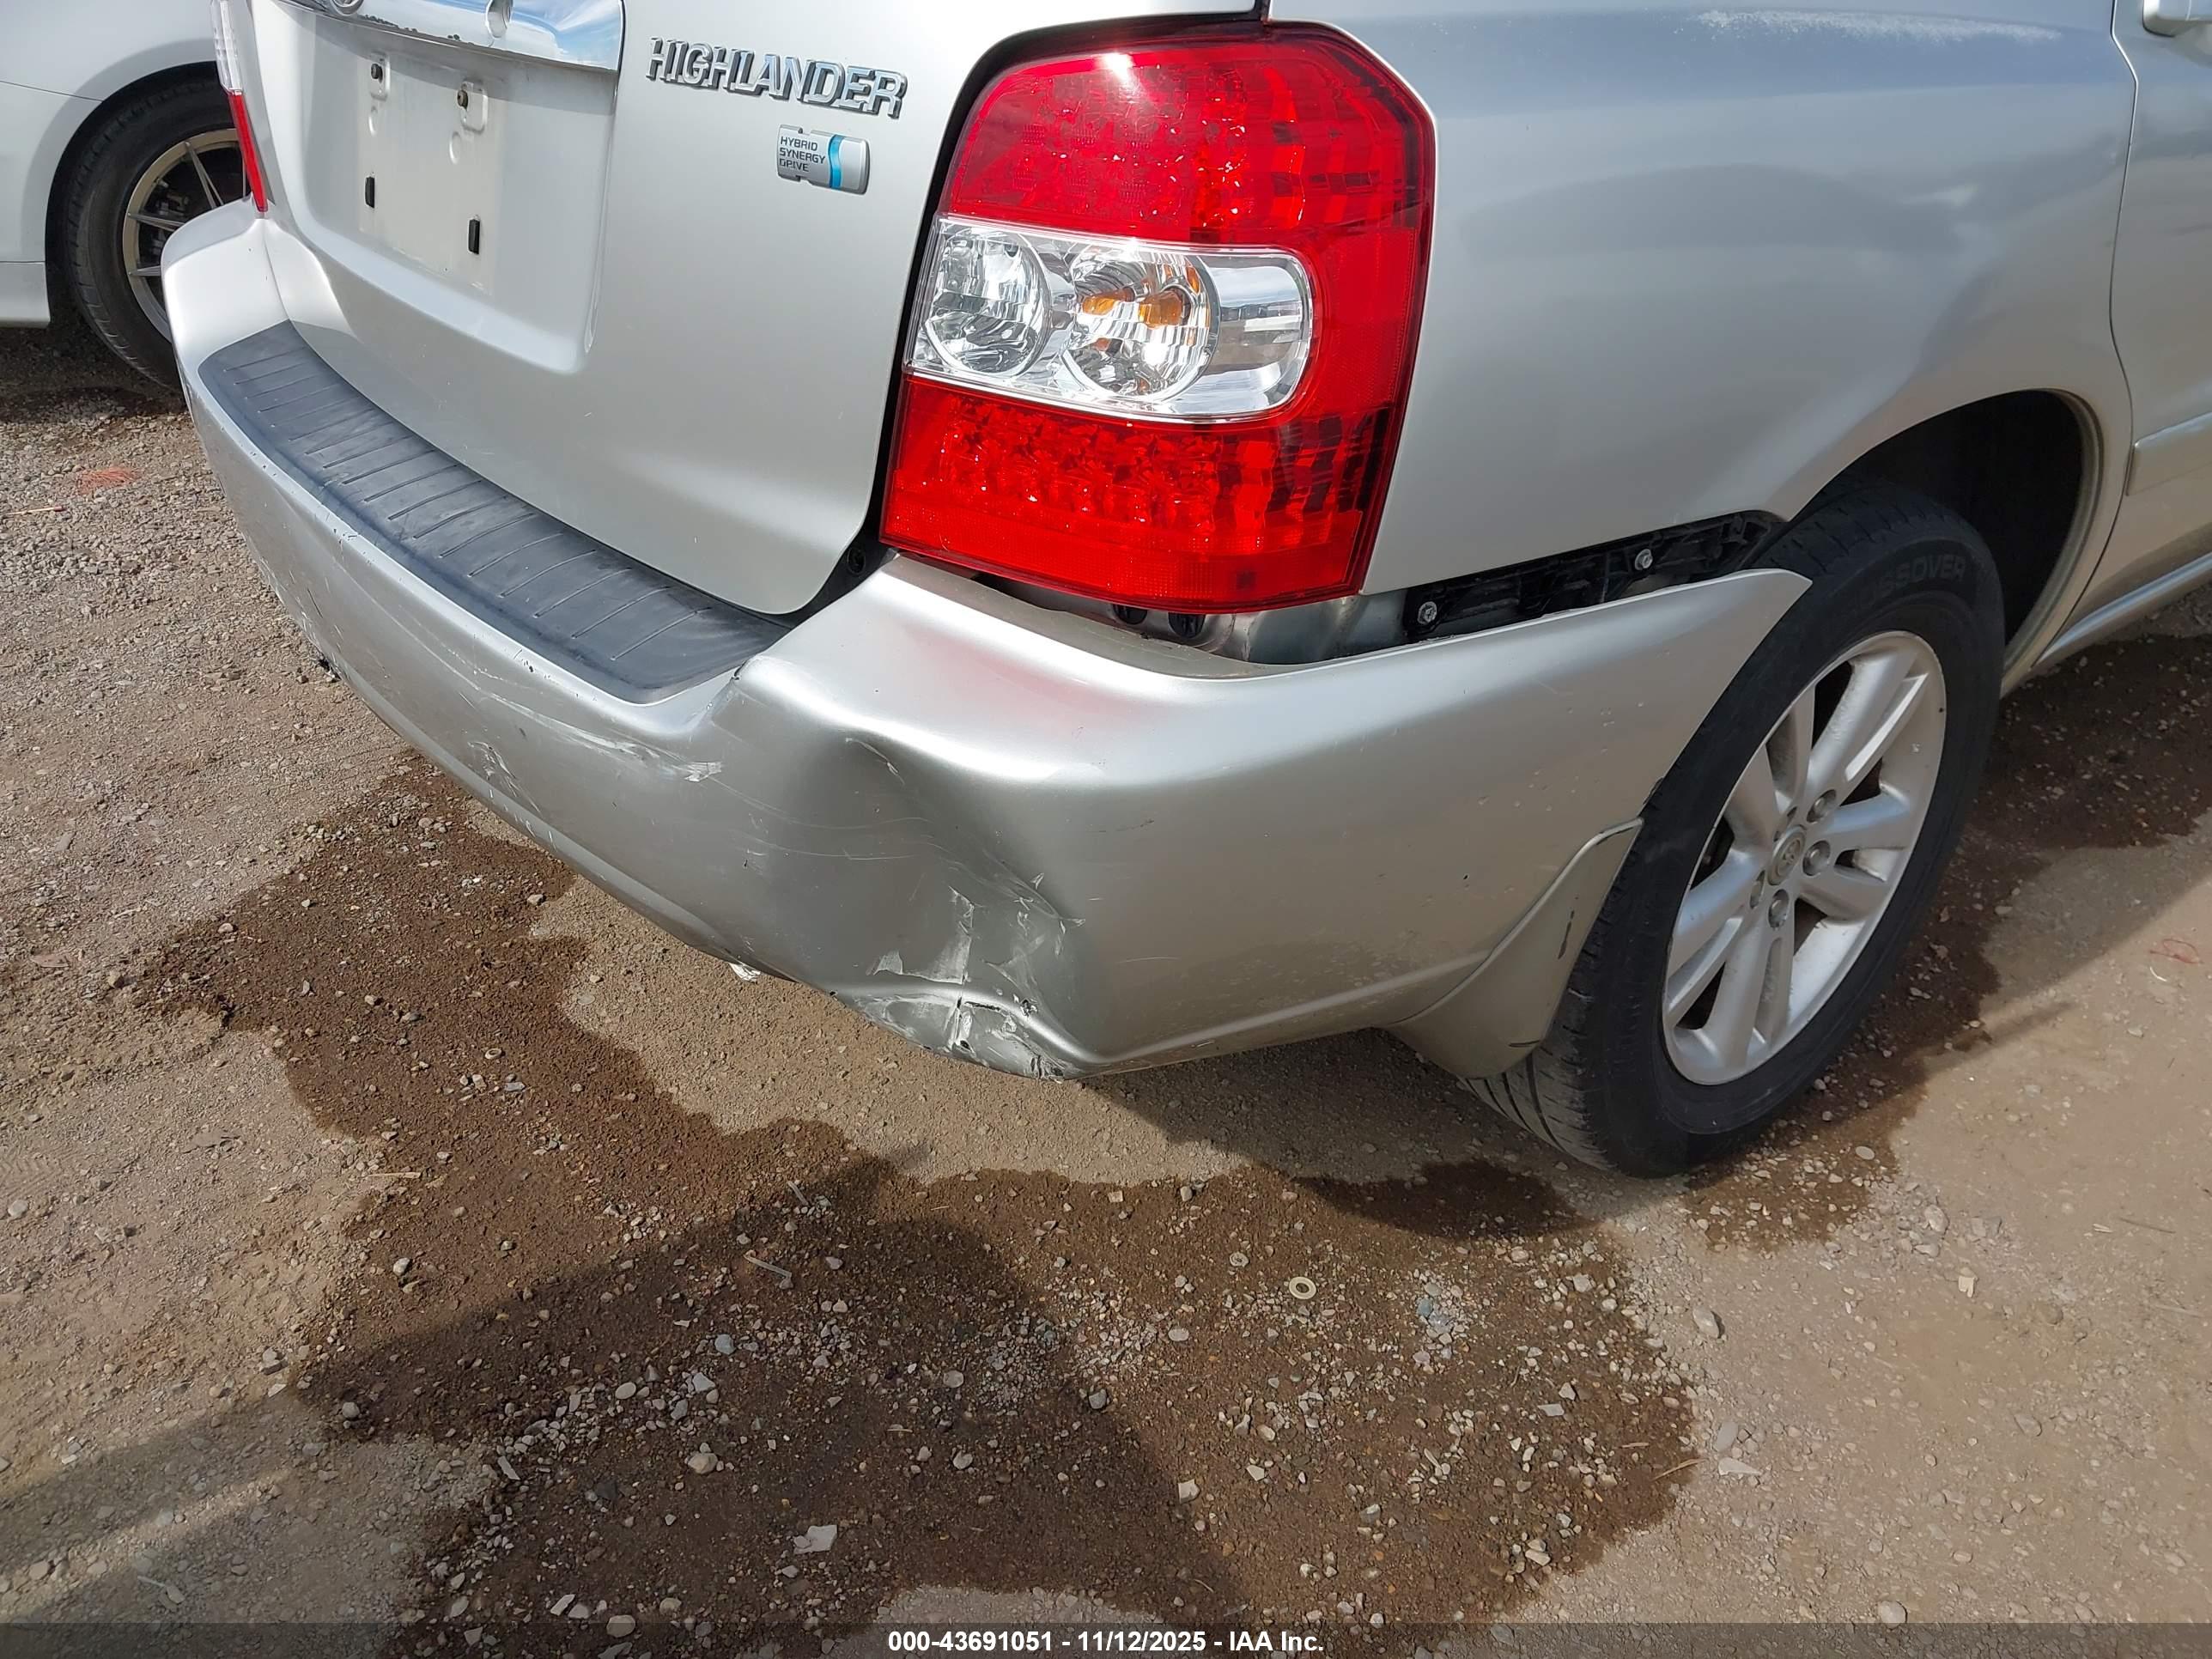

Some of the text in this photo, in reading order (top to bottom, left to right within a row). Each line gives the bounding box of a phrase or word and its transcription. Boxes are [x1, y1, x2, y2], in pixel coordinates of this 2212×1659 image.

[646, 36, 908, 119] HIGHLANDER
[780, 136, 818, 152] HYBRID
[779, 147, 826, 164] SYNERGY
[779, 158, 810, 173] DRIVE
